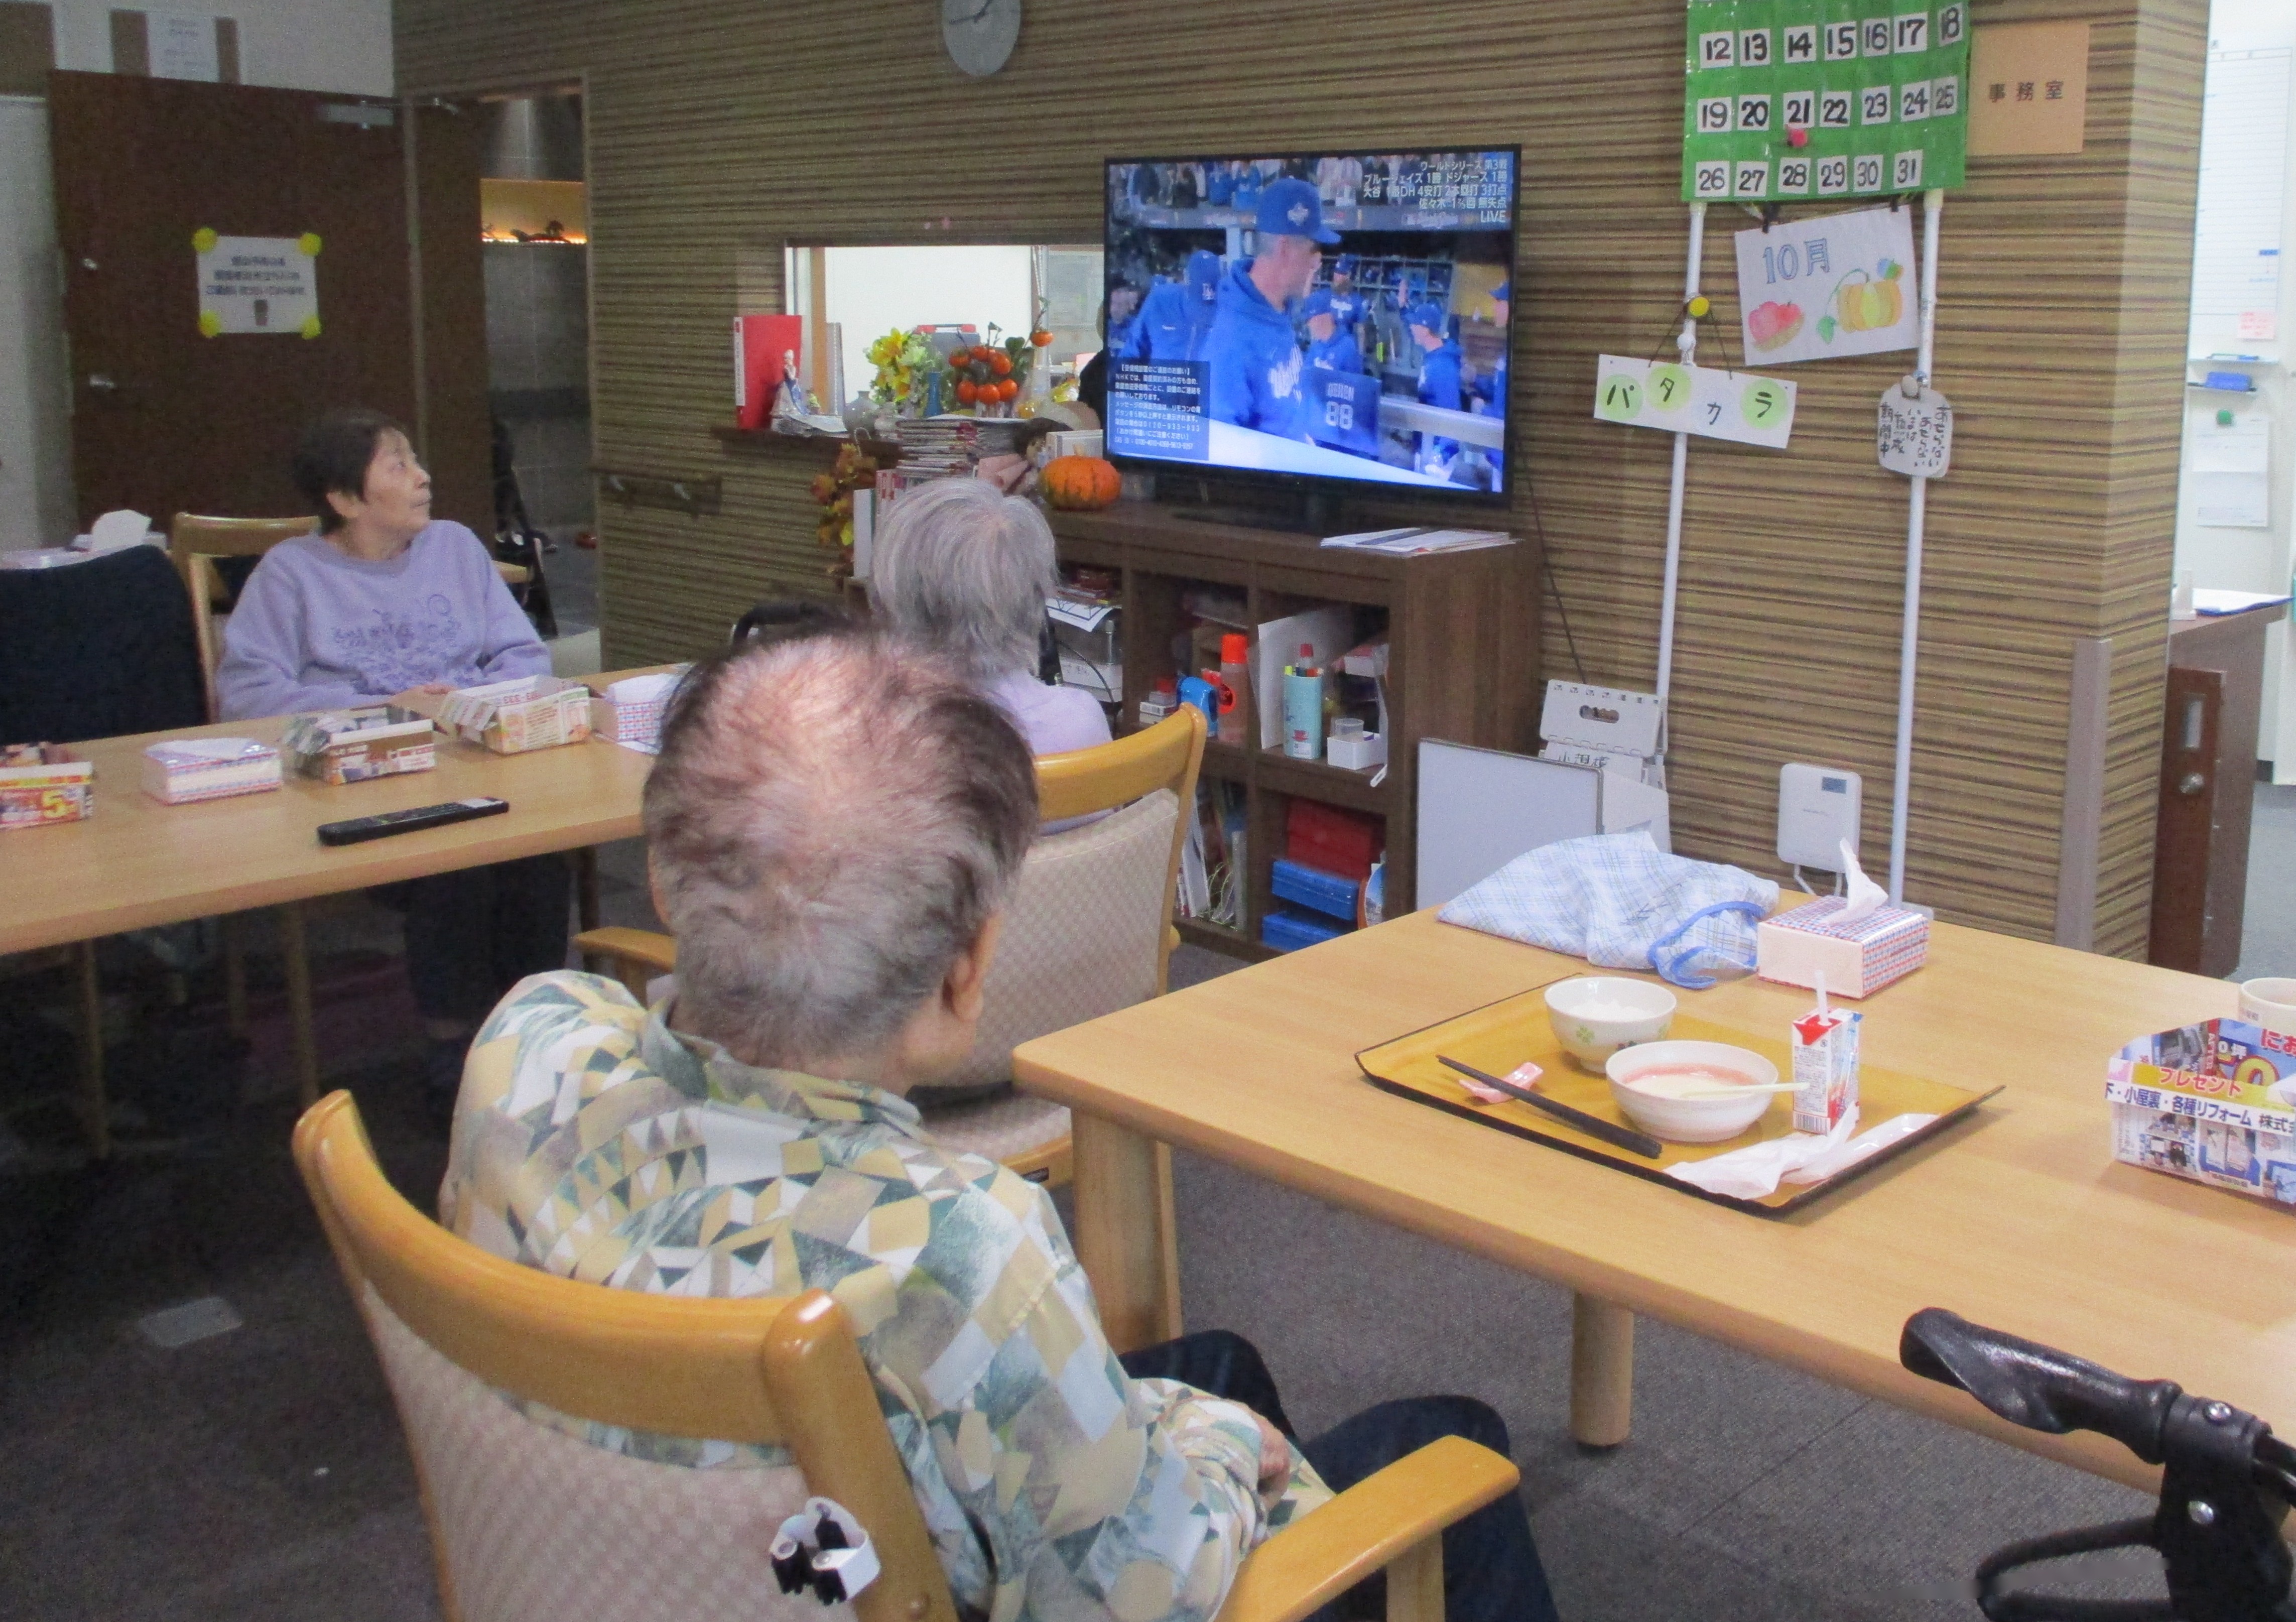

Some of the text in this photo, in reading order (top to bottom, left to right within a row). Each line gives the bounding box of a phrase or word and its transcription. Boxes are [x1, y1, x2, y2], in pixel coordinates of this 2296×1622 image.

[1706, 7, 1960, 61] 12 13 14 15 16 17 18
[1989, 80, 2064, 103] 事務室
[1702, 84, 1955, 129] 19 20 21 22 23 24 25
[1446, 171, 1488, 183] ドジャース
[1699, 158, 1917, 192] 26 27 28 29 30 31
[1363, 185, 1381, 198] 大谷
[1418, 184, 1442, 197] 4安打
[1481, 183, 1506, 196] 3打点
[1419, 197, 1446, 209] 佐々木
[1481, 210, 1506, 223] LIVE
[1762, 238, 1830, 284] 10月
